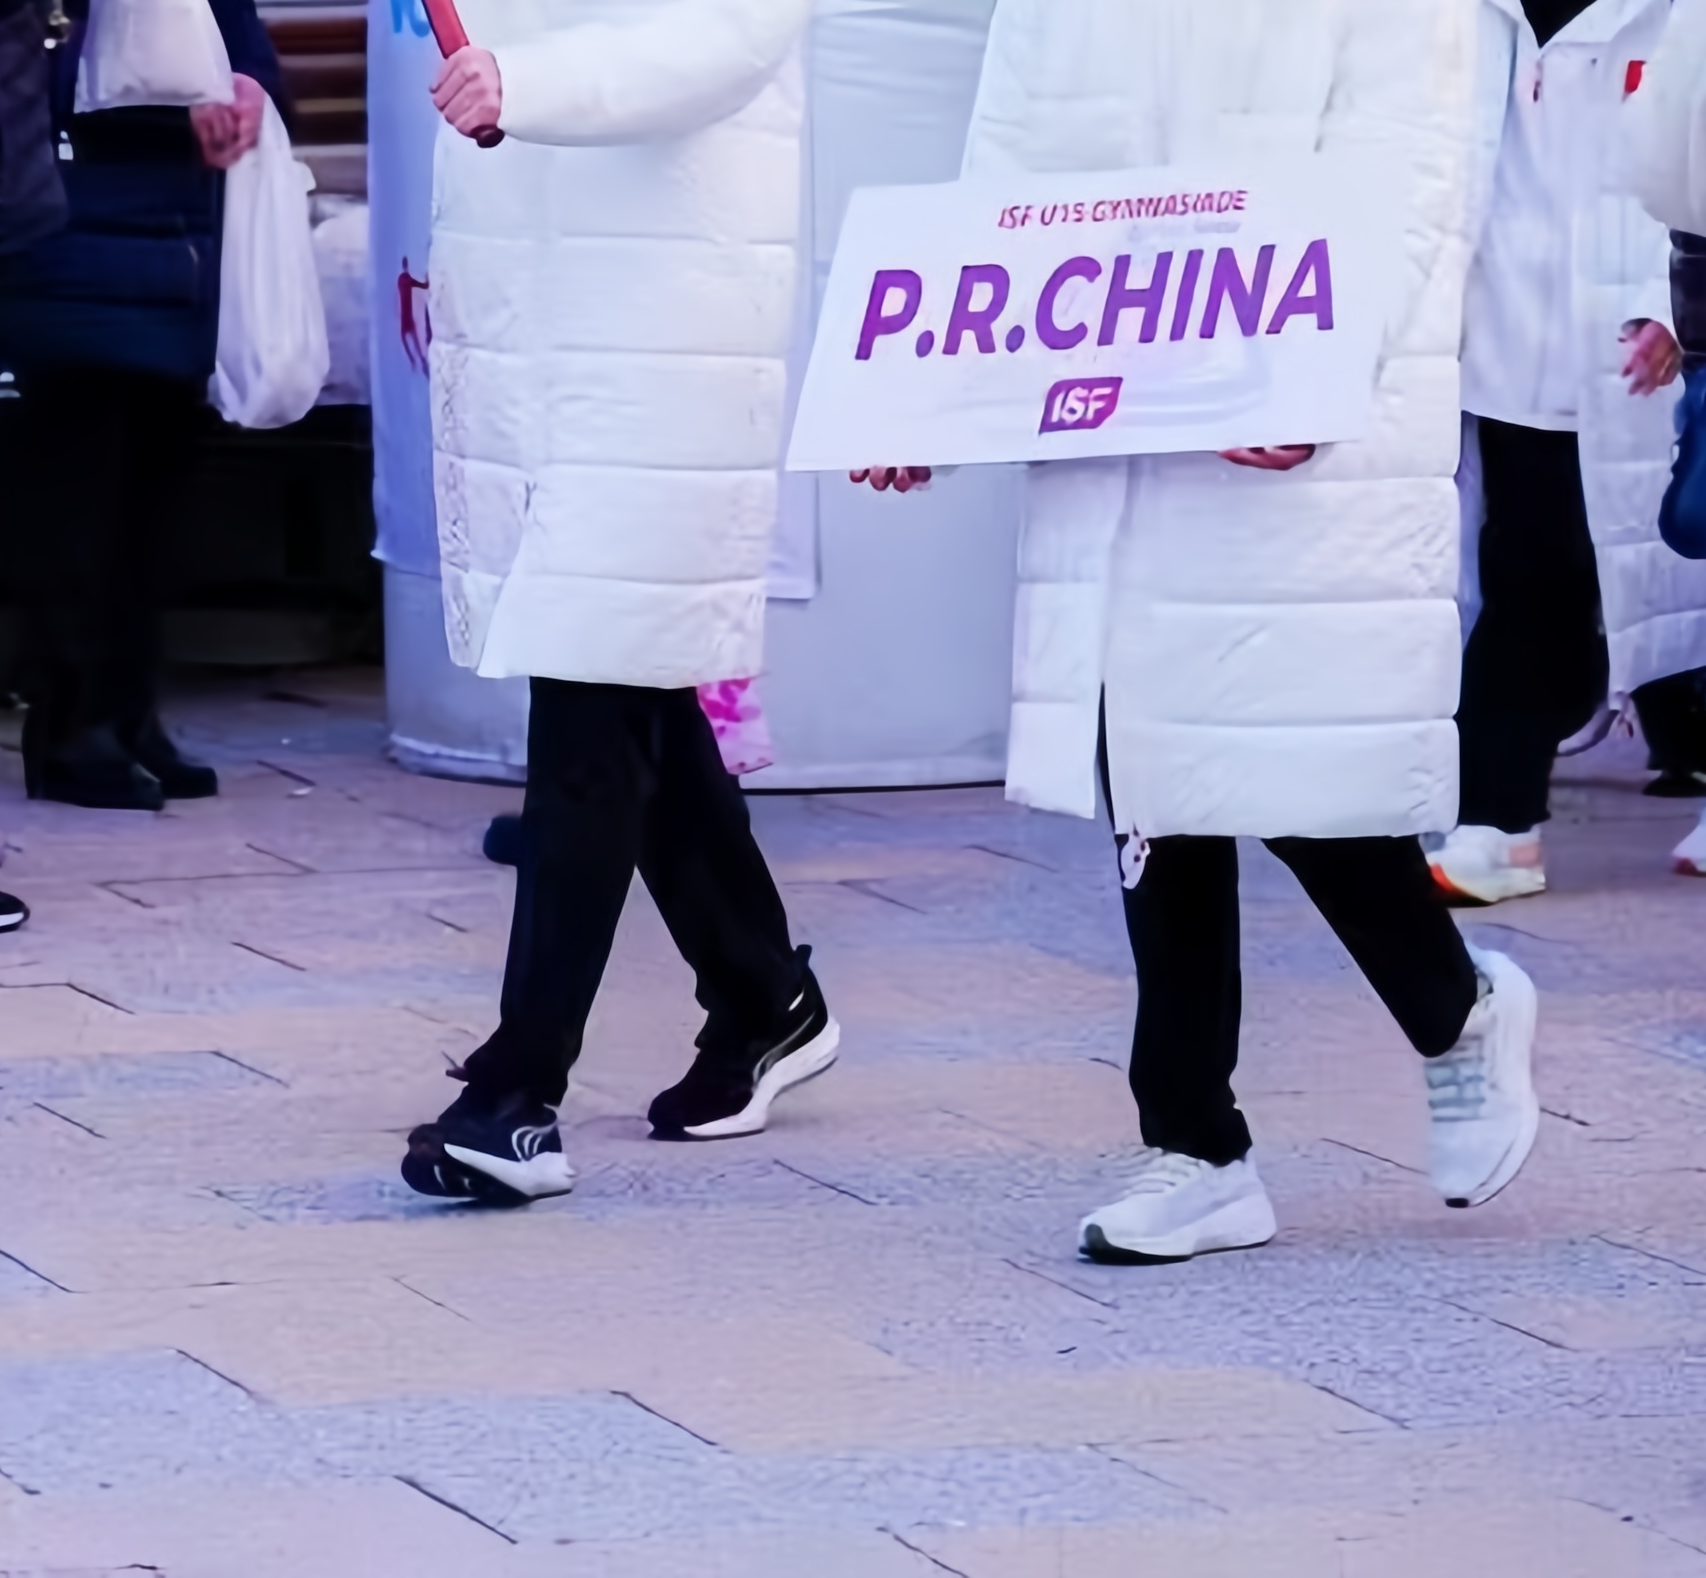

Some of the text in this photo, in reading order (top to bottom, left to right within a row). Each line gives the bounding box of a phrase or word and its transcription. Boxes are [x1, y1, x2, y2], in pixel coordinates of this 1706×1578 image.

[997, 205, 1034, 229] ISF
[1040, 202, 1086, 226] U15
[854, 238, 1335, 361] P.R.CHINA
[1051, 386, 1113, 425] ISF
